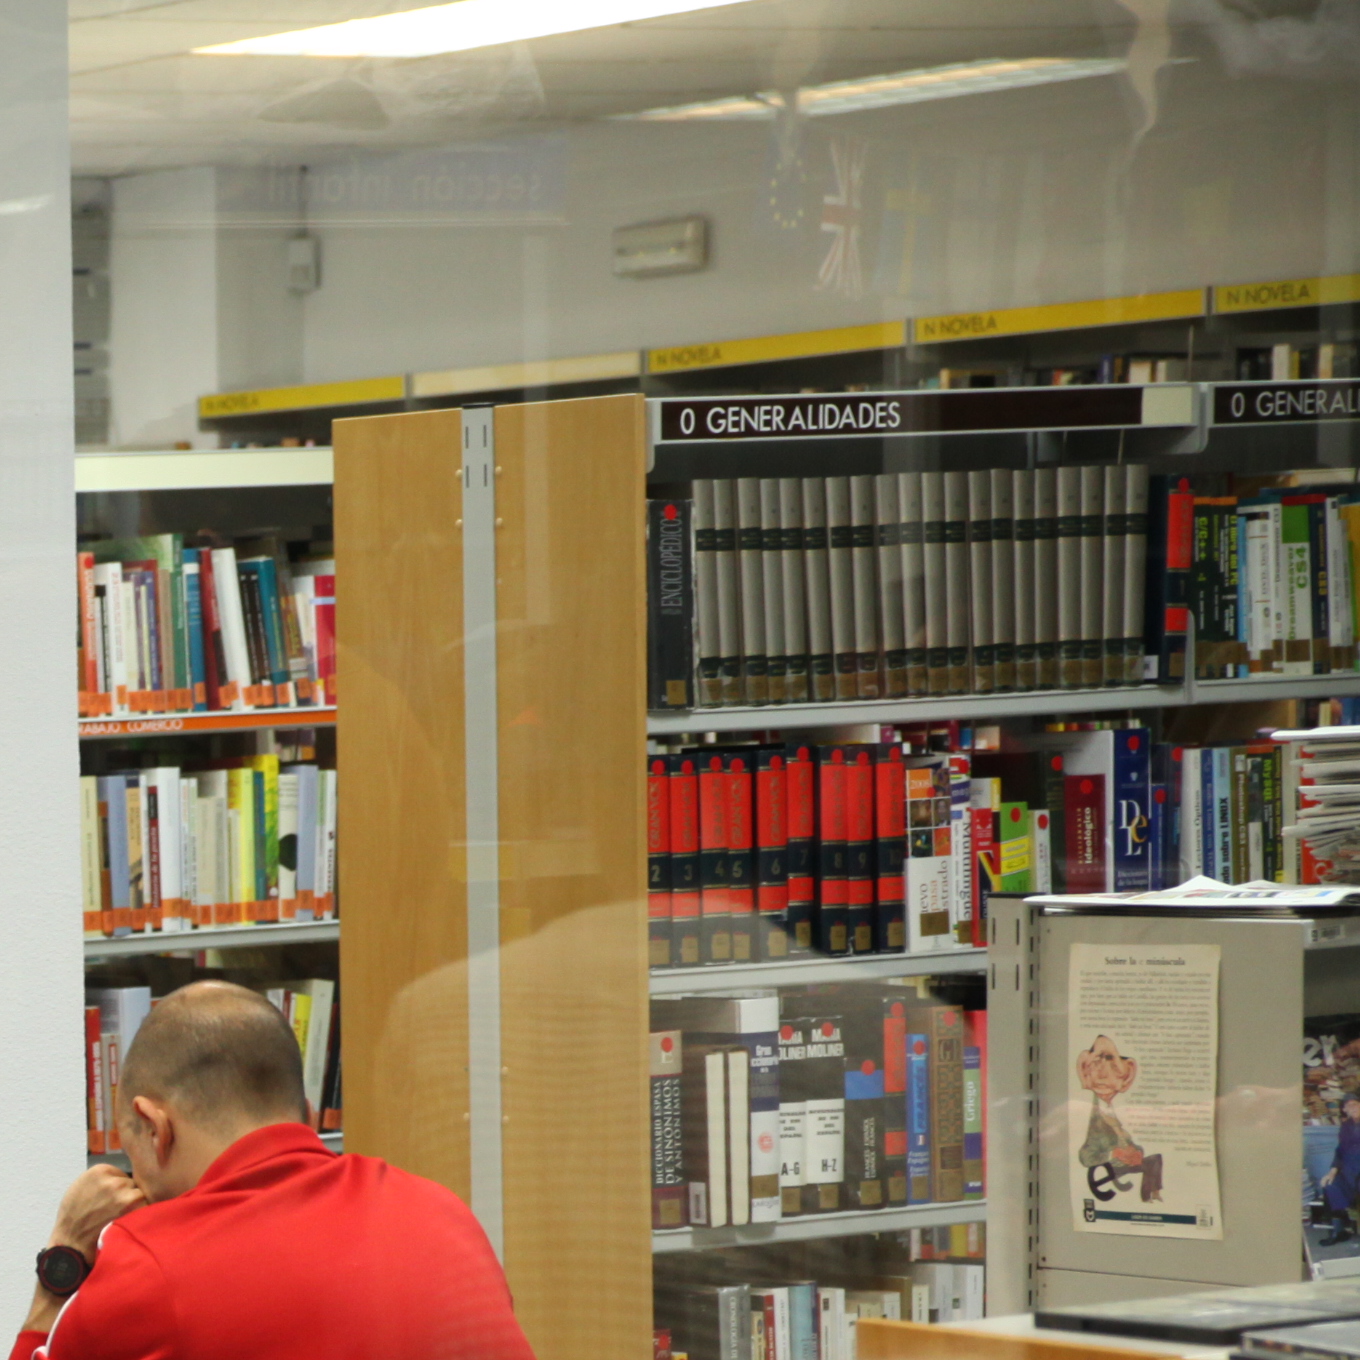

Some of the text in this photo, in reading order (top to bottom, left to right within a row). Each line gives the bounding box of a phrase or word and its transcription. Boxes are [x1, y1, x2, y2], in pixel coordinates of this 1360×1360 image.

[1245, 283, 1311, 304] NOVELA
[940, 315, 998, 334] NOVELA
[671, 346, 722, 366] NOVELA
[680, 401, 901, 435] 0 GENERALIDADES
[658, 517, 682, 607] ENCICLOPÉDICO
[1263, 758, 1273, 802] MySQL
[1219, 797, 1228, 830] LINUX
[715, 859, 725, 877] 4
[771, 857, 781, 876] 6
[834, 851, 843, 868] 8
[858, 850, 867, 868] 9
[651, 865, 661, 882] 2
[684, 865, 693, 882] 3
[732, 860, 743, 878] 5
[1105, 956, 1127, 966] Sobre
[806, 1042, 845, 1059] MOLINER
[965, 1081, 976, 1122] Griego
[653, 1081, 664, 1185] DICCIONARIO ESPASA
[780, 1161, 801, 1177] A-G
[821, 1158, 837, 1173] H-Z
[664, 1166, 675, 1186] DE
